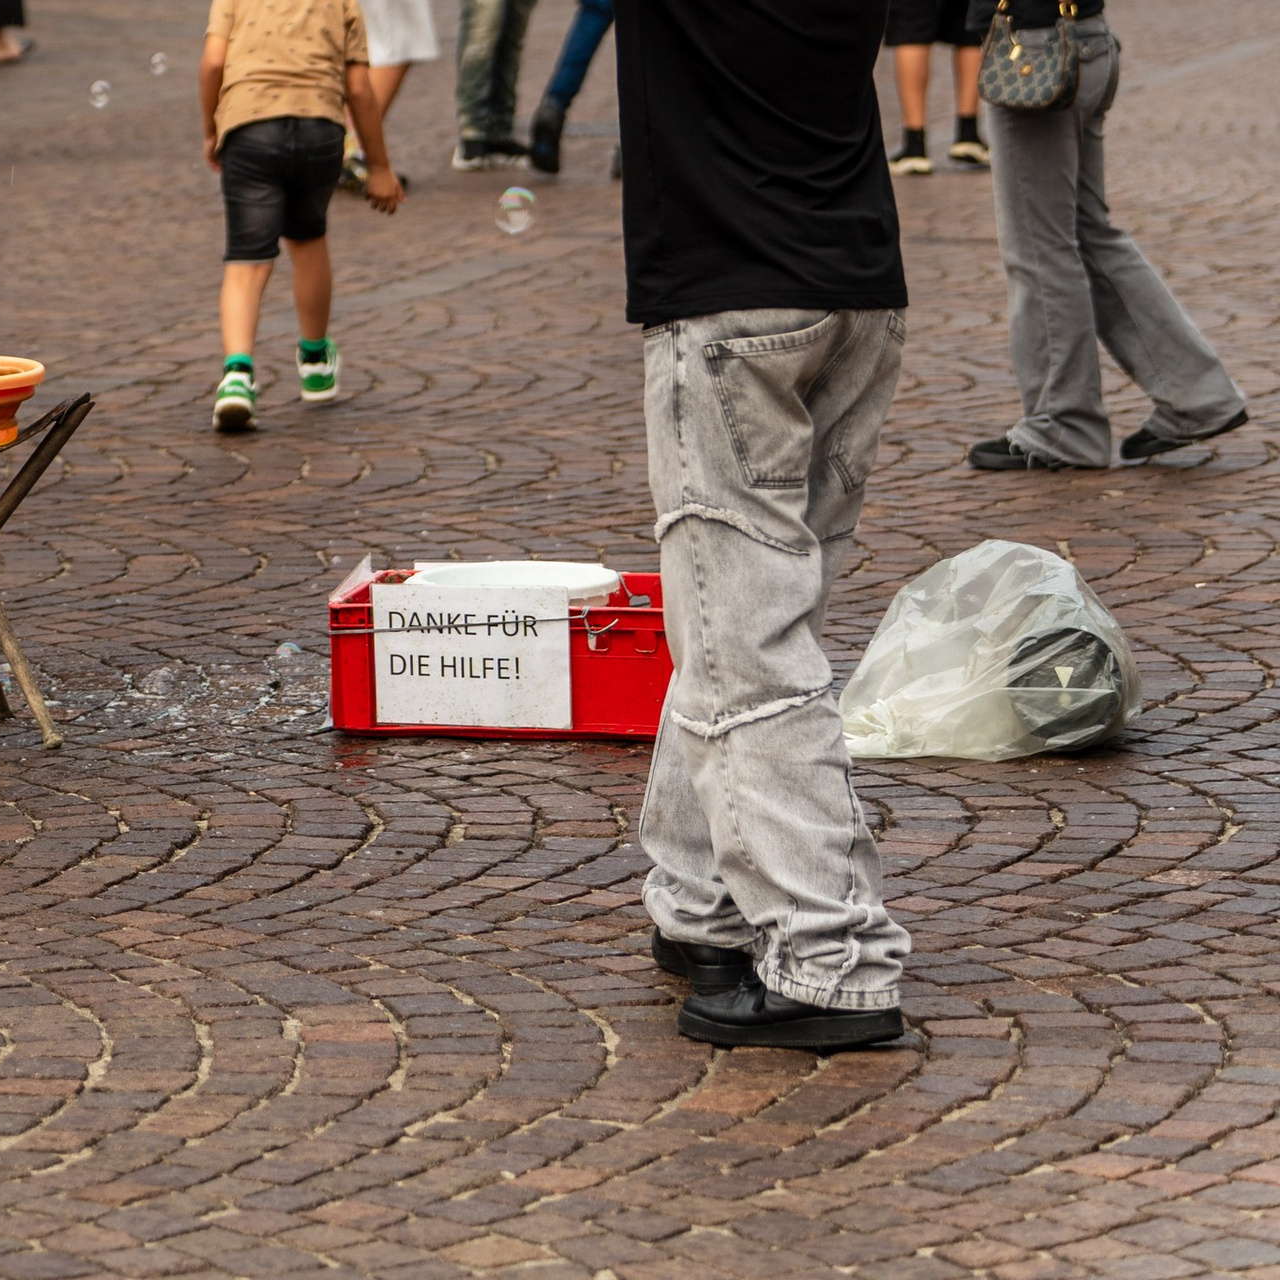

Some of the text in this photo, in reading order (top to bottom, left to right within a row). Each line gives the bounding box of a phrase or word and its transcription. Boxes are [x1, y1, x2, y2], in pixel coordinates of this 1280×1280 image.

[388, 610, 538, 637] DANKE FÜR
[390, 654, 520, 680] DIE HILFE!
